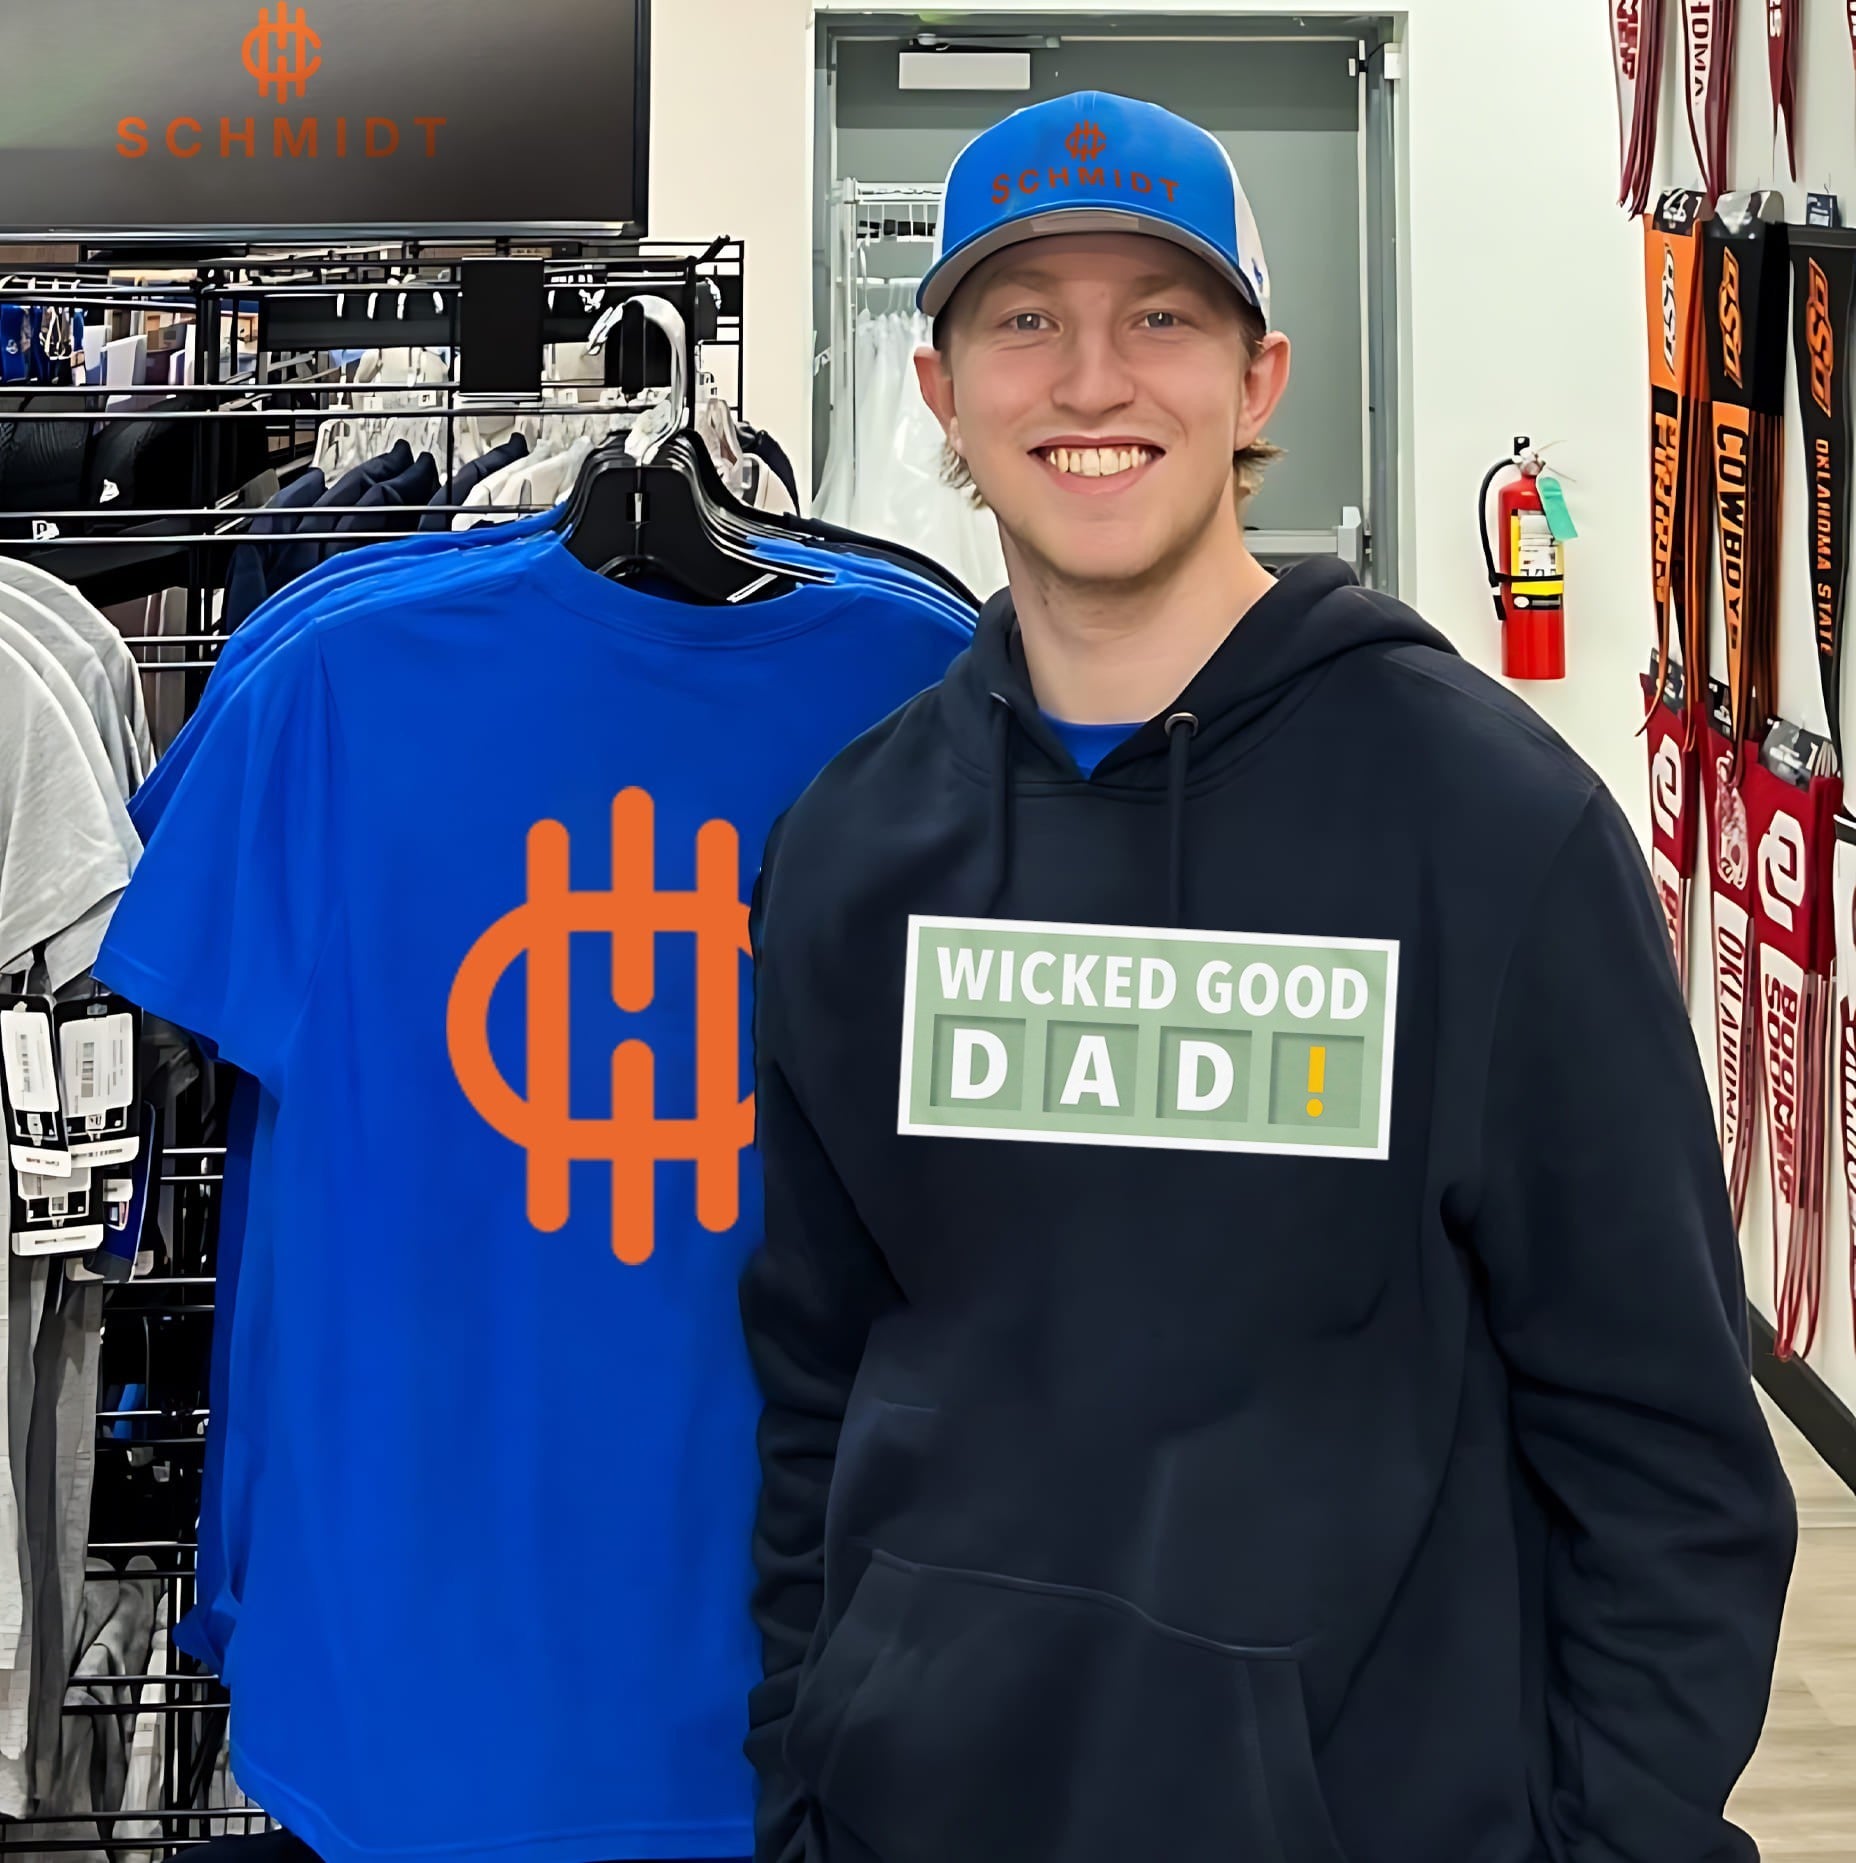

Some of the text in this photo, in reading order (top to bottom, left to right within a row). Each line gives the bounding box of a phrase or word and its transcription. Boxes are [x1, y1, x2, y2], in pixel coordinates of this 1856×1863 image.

[116, 117, 447, 159] SCHMIDT
[992, 167, 1181, 205] SCHMIDT
[1815, 439, 1832, 570] OKLAHOMA
[936, 946, 1369, 1019] WICKED GOOD
[1718, 926, 1745, 1144] OKLAHOMA
